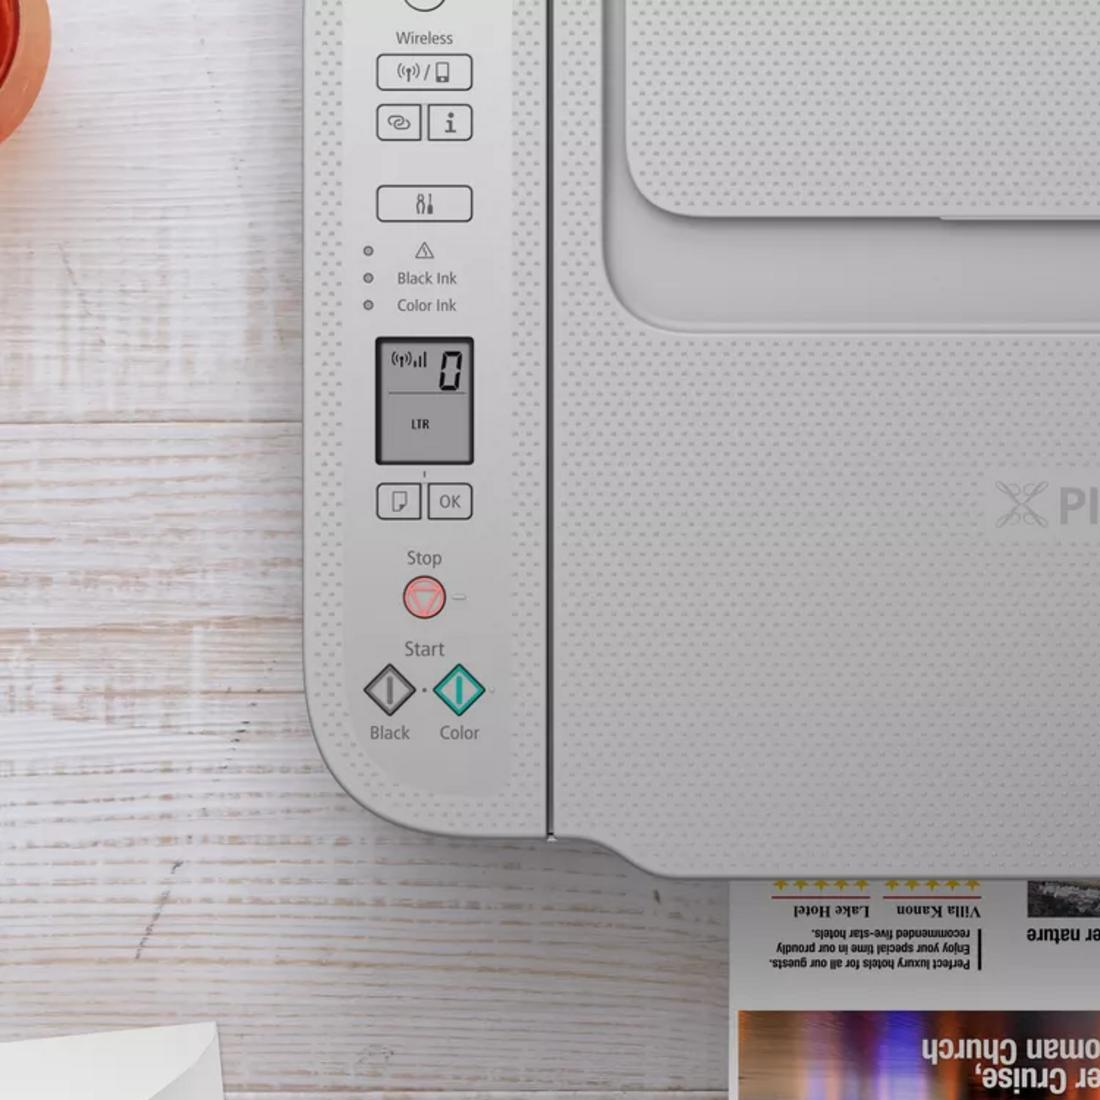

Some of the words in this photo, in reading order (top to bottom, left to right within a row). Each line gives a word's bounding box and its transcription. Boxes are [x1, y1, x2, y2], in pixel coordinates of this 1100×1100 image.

[396, 31, 454, 45] Wireless
[397, 271, 433, 285] Black
[437, 271, 457, 285] Ink
[397, 298, 432, 312] Color
[436, 298, 457, 312] Ink
[411, 419, 430, 430] LTR
[439, 494, 462, 508] OK
[407, 550, 443, 568] Stop
[404, 640, 445, 657] Start
[370, 725, 410, 740] Black
[440, 725, 480, 740] Color
[793, 905, 830, 918] Hotel
[835, 905, 870, 918] Lake
[897, 905, 942, 918] Kanon
[947, 905, 981, 918] Villa
[811, 929, 846, 940] hotels.
[849, 929, 893, 940] five-star
[896, 929, 970, 940] recommended
[1027, 928, 1080, 945] nature
[776, 942, 816, 954] proudly
[818, 943, 836, 952] our
[838, 942, 848, 954] in
[851, 942, 874, 954] time
[876, 942, 914, 954] special
[916, 942, 940, 952] your
[943, 942, 970, 954] Enjoy
[769, 958, 807, 970] guests.
[810, 959, 827, 968] our
[830, 958, 843, 970] all
[845, 958, 860, 970] for
[863, 958, 895, 970] hotels
[897, 957, 930, 970] luxury
[932, 958, 970, 970] Perfect
[921, 1038, 1017, 1065] Church
[975, 1063, 1066, 1094] Cruise,
